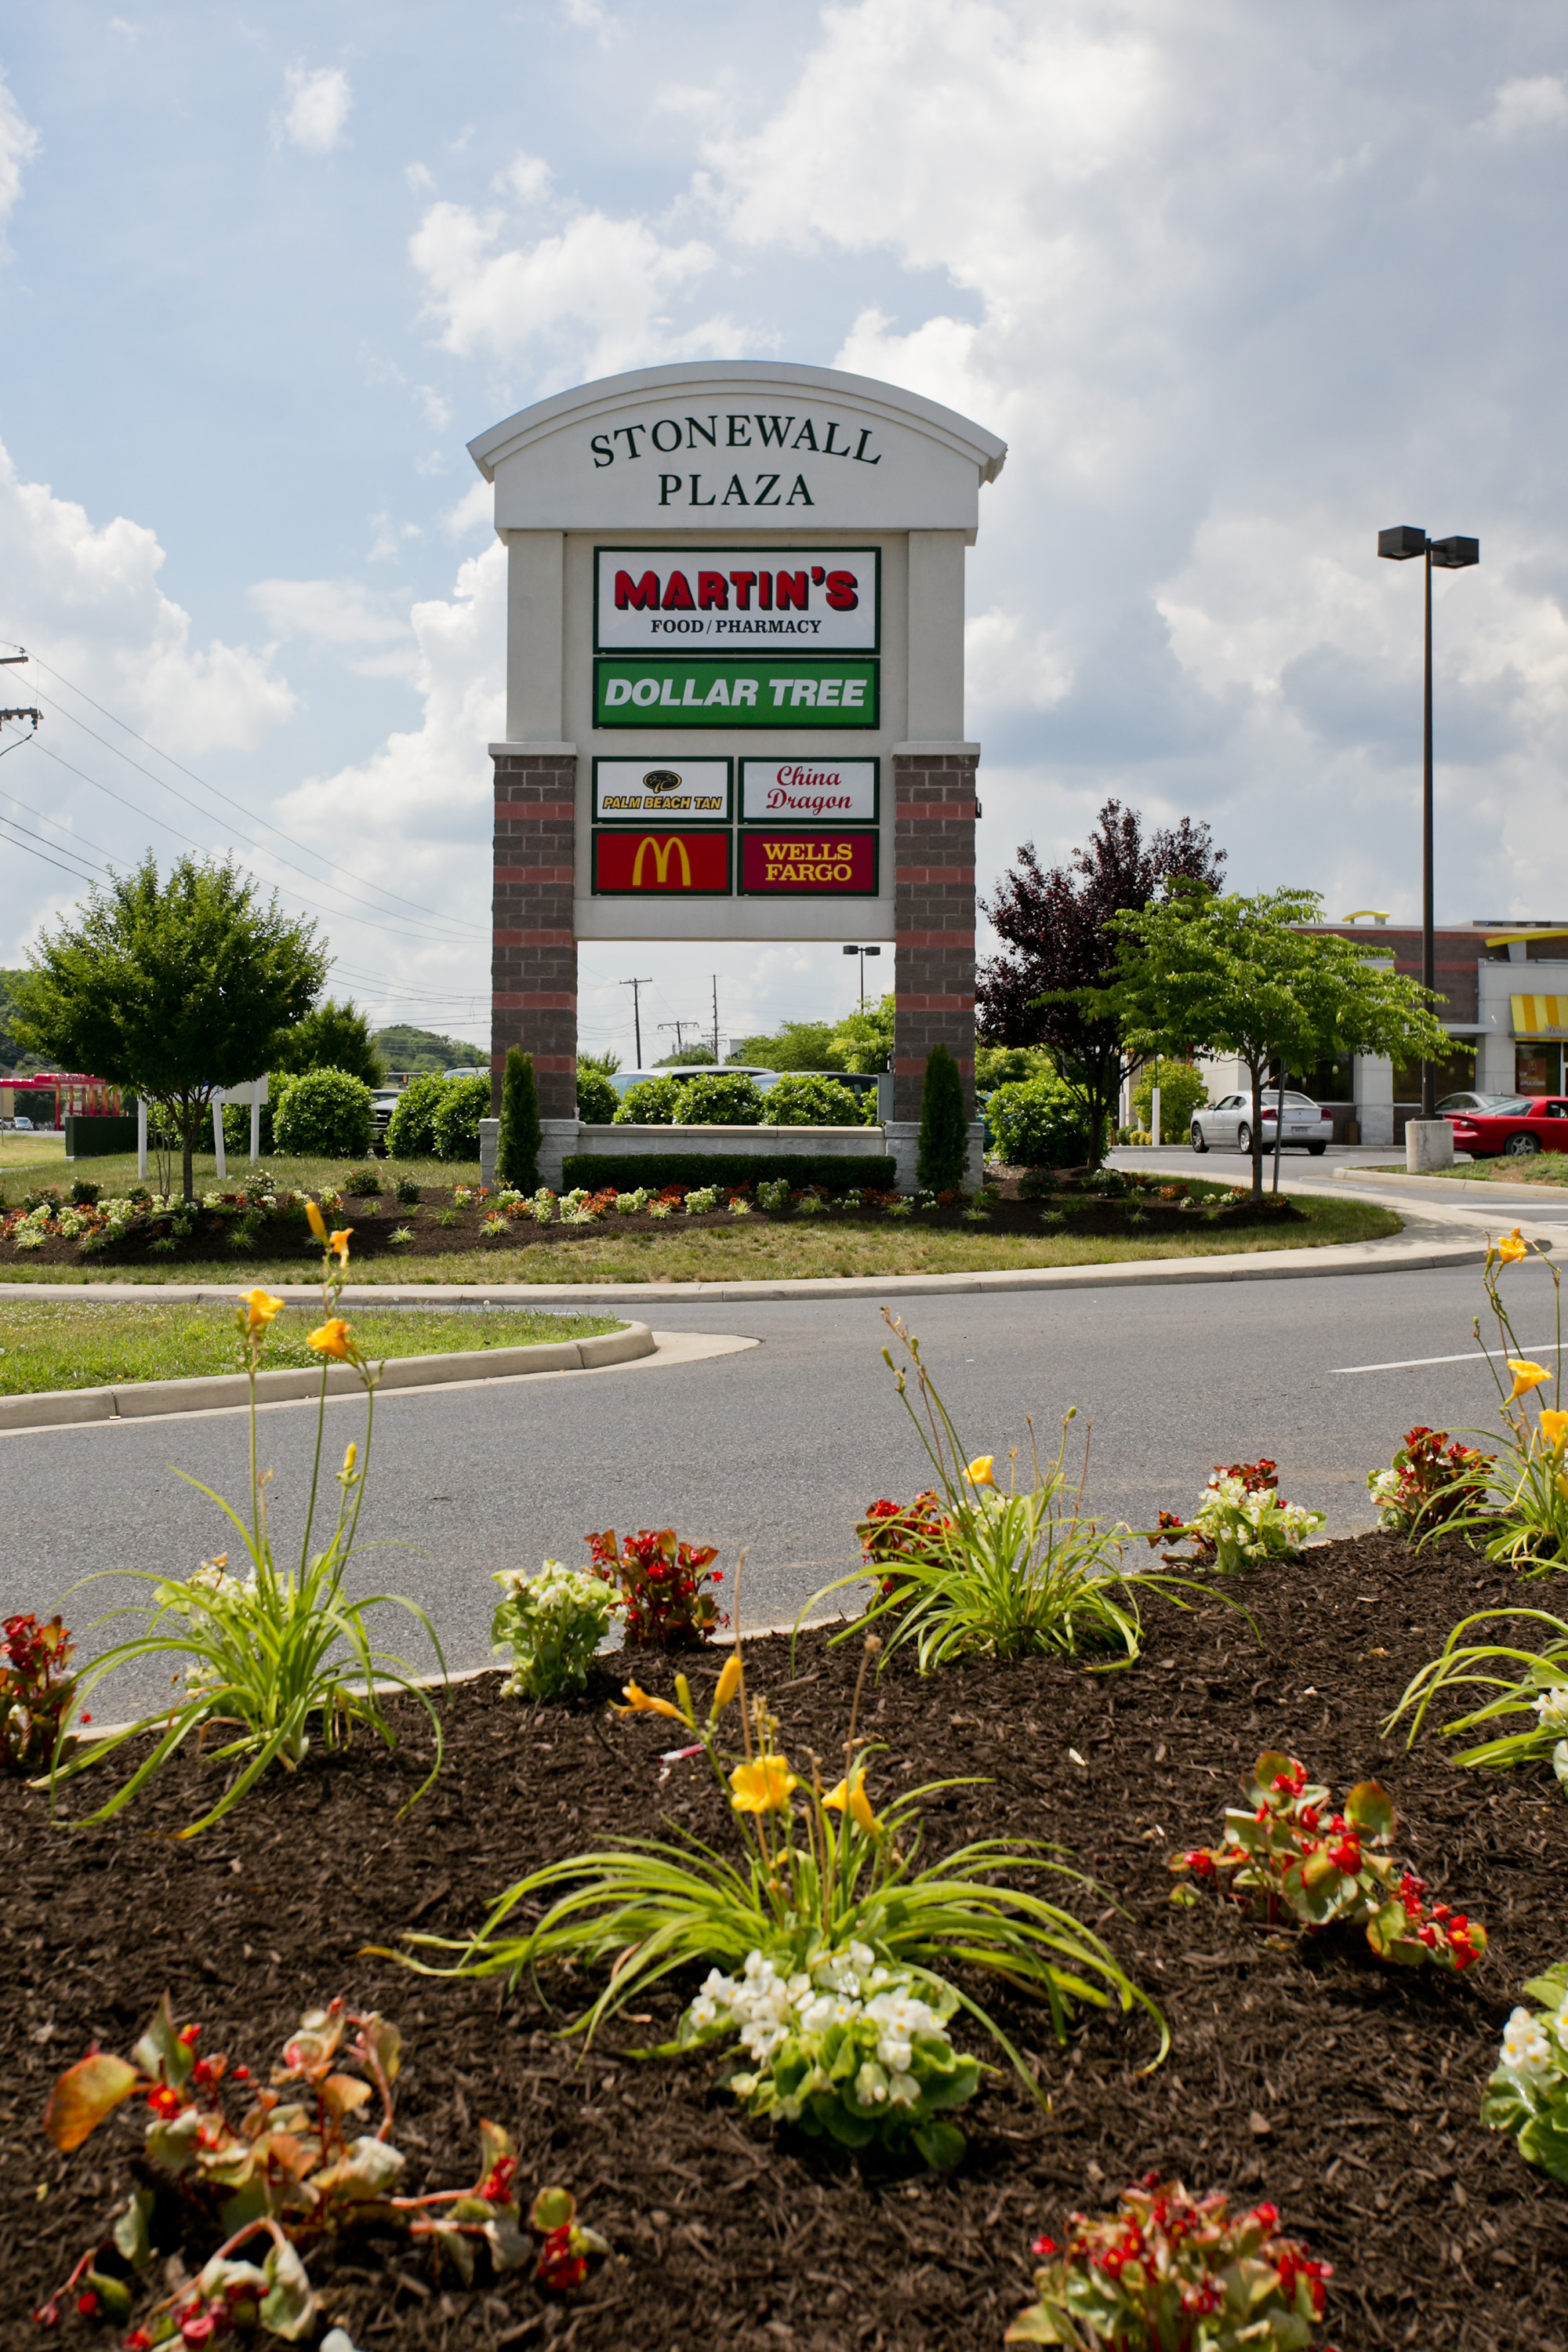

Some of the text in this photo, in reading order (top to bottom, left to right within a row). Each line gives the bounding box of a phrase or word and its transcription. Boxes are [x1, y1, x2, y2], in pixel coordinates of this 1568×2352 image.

[590, 414, 882, 469] STONEWALL
[658, 474, 815, 506] PLAZA
[615, 566, 859, 612] MARTIN'S
[604, 677, 868, 707] DOLLAR TREE
[776, 765, 842, 786] China
[602, 796, 723, 810] PALM BEACH TAN
[766, 788, 853, 815] Dragon
[762, 844, 853, 860] WELLS
[765, 864, 852, 881] FARGO
